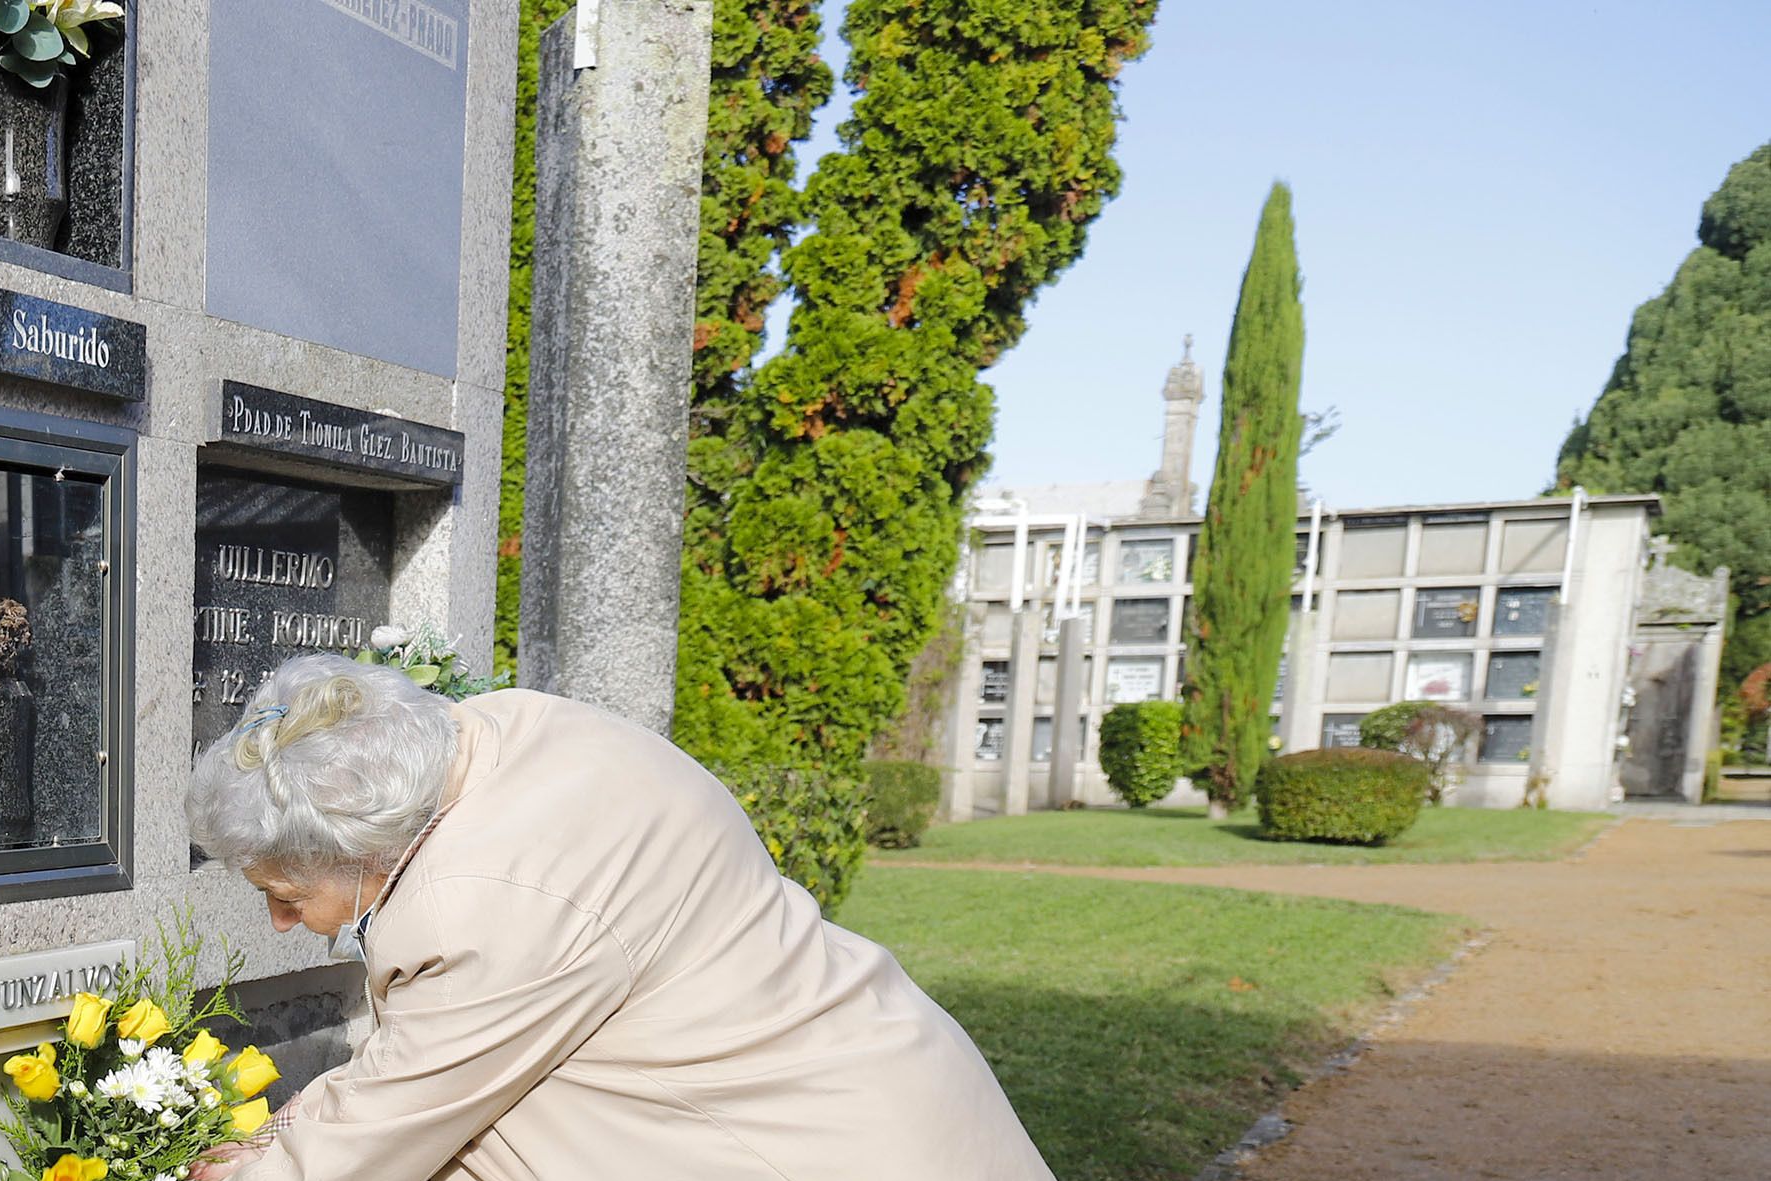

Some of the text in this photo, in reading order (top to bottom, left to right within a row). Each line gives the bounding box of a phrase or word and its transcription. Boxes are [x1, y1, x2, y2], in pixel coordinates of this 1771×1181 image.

[11, 309, 110, 369] Saburido
[300, 410, 353, 453] TIONILA
[401, 431, 458, 472] BAUTISTA
